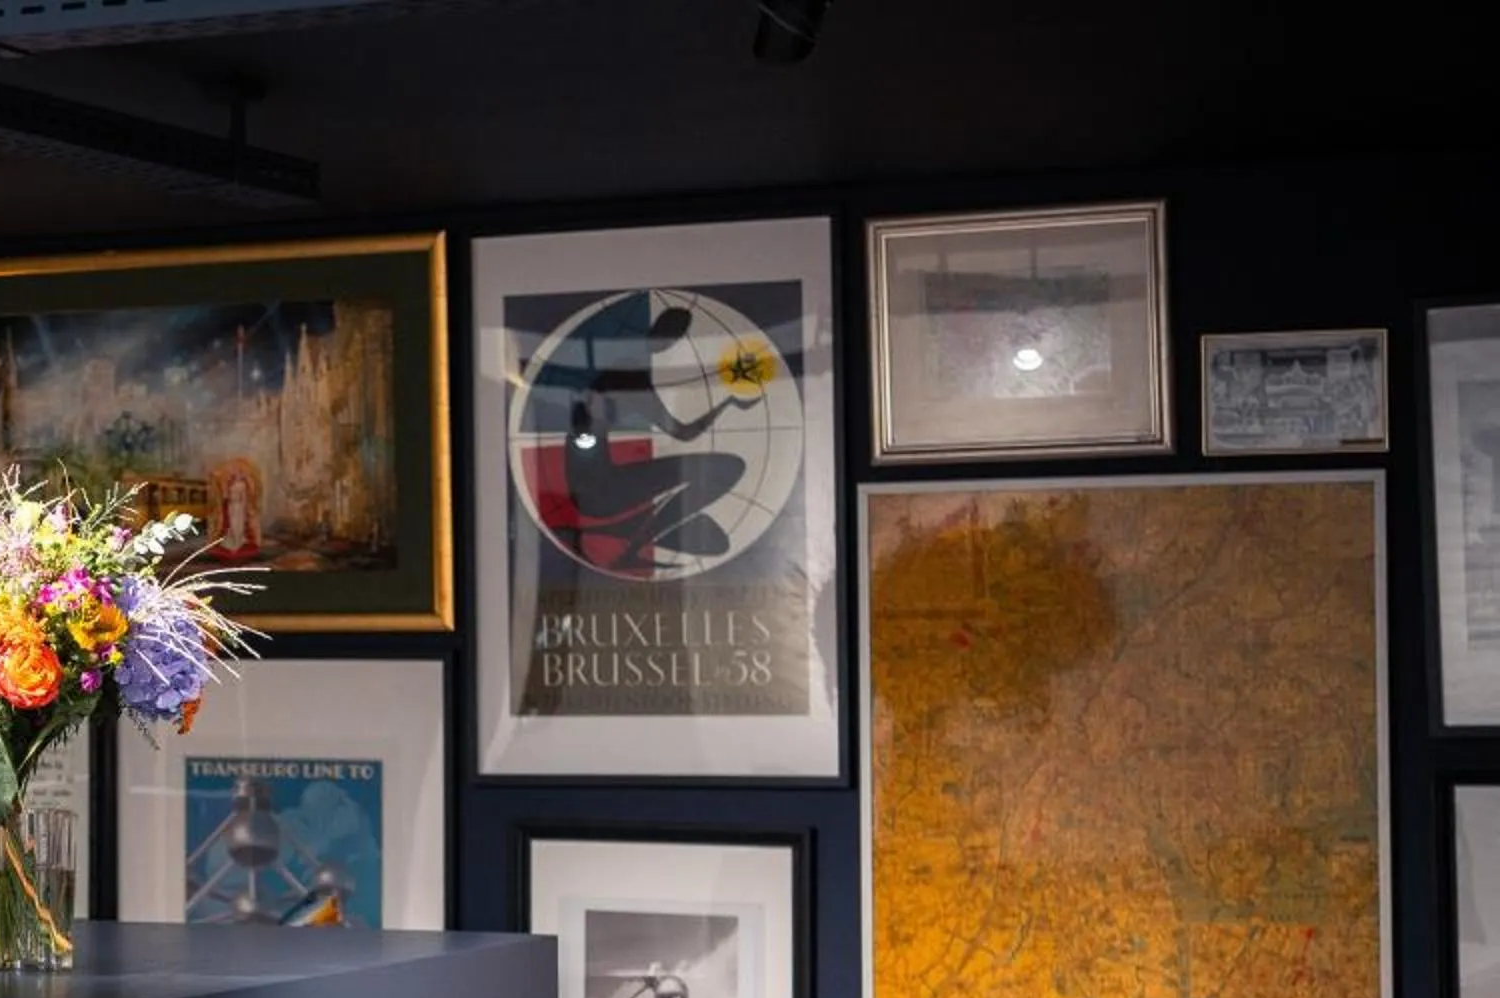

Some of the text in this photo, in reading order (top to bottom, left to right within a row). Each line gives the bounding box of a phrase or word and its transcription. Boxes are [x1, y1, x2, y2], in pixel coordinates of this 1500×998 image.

[541, 610, 771, 648] BRUXELLES
[543, 651, 712, 687] BRUSSEL
[191, 761, 375, 780] TRANSEURO LINE TO
